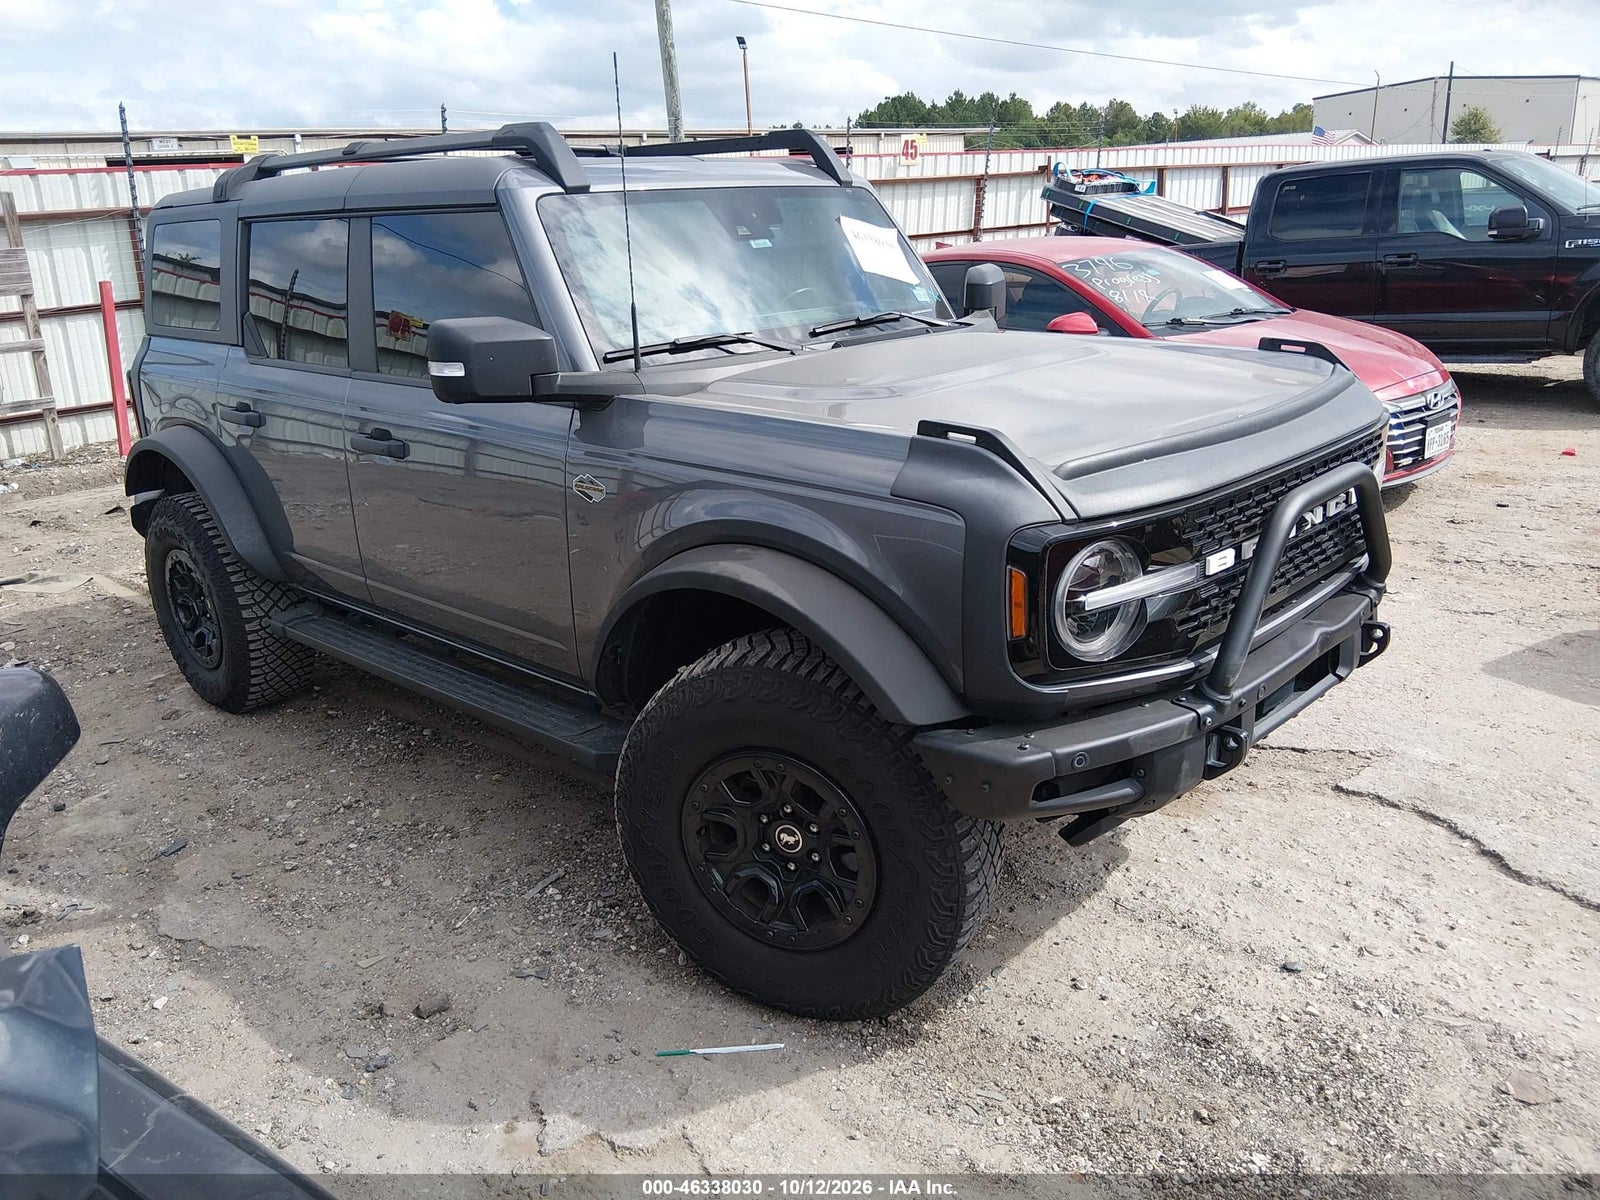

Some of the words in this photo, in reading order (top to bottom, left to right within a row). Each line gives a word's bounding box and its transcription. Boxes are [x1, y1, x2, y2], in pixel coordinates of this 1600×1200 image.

[902, 140, 918, 160] 45
[1565, 239, 1600, 248] F15
[1062, 257, 1133, 279] 3796
[1205, 487, 1357, 576] BNC
[637, 745, 720, 953] GOODYEAR
